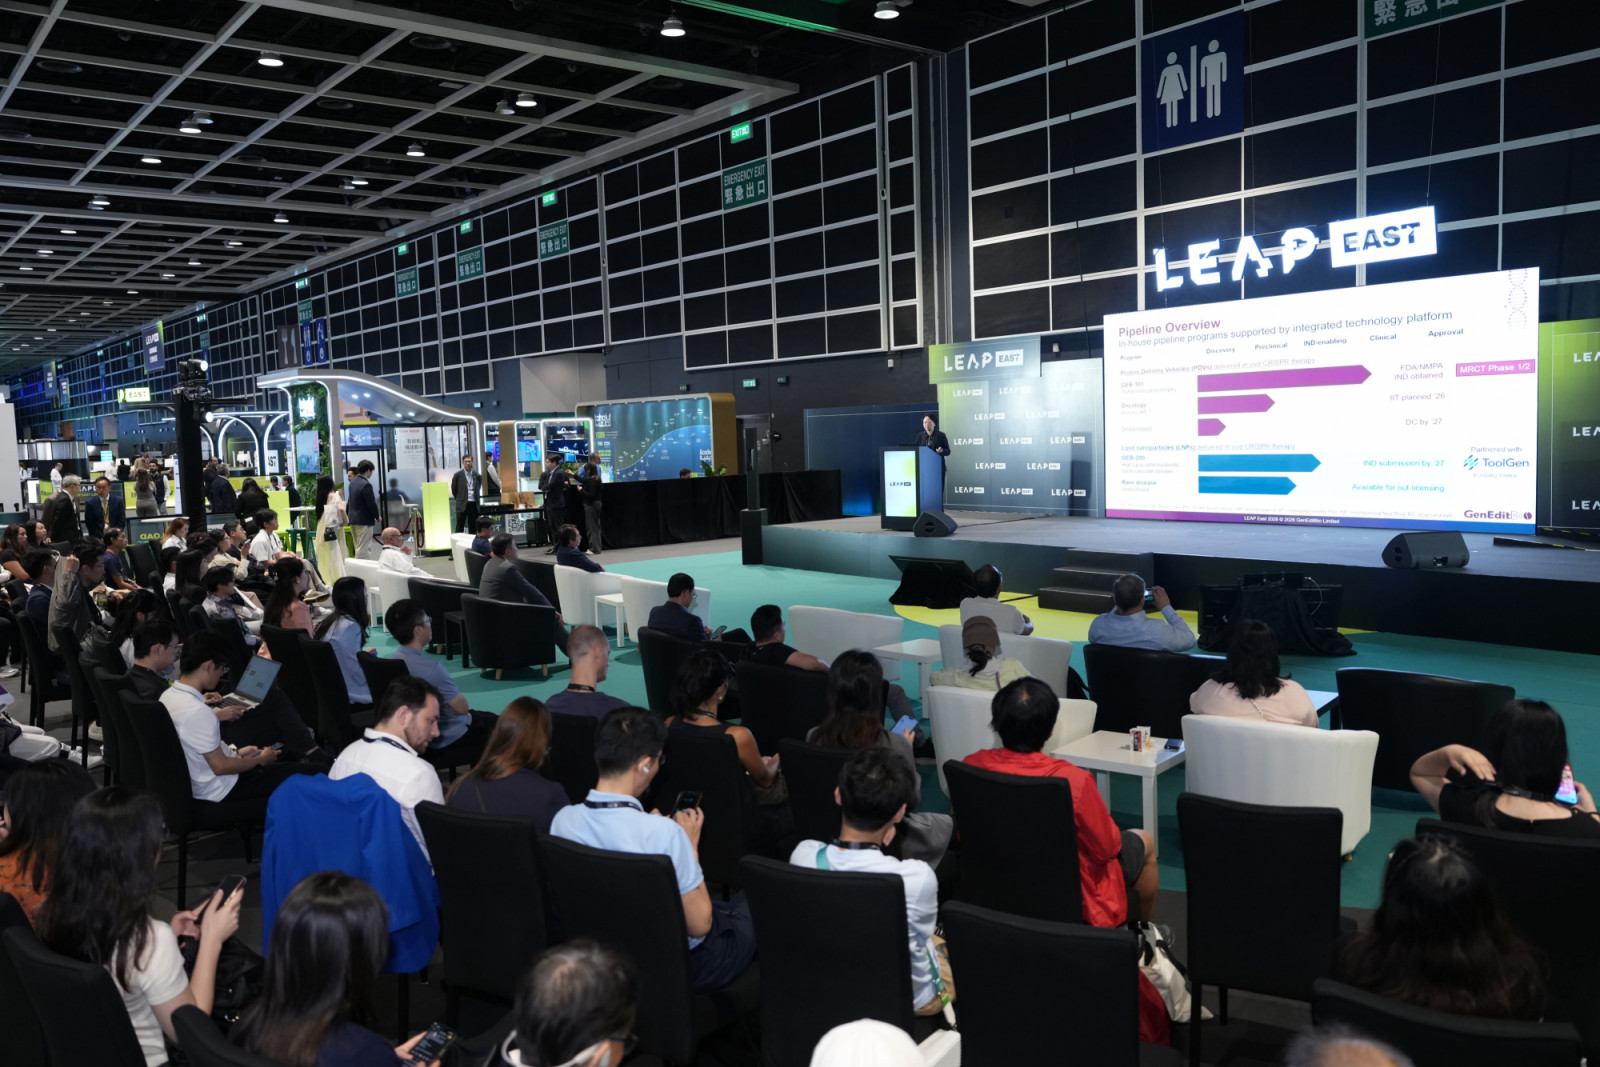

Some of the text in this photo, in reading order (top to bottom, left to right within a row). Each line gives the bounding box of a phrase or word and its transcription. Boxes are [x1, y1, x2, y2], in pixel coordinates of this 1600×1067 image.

[724, 164, 765, 186] EMERGENCY EXIT
[724, 180, 765, 204] 緊急出口
[540, 226, 559, 240] EMERGENCY
[1152, 222, 1422, 292] LEAP EAST
[1119, 320, 1221, 338] Pipeline Overview
[1119, 311, 1452, 347] In-house pipeline programs supported by integrated technology platform
[1206, 346, 1235, 354] Discovery
[1254, 342, 1288, 350] Preclinical
[1304, 338, 1347, 347] IND-enabling
[1428, 328, 1464, 338] Approval
[944, 352, 1020, 372] LEAP EAST
[1400, 362, 1443, 371] FDA/NMPA
[1488, 364, 1514, 372] Phase
[1518, 362, 1530, 370] 1/2
[1410, 372, 1443, 380] obtained
[1402, 393, 1431, 401] planned
[1420, 418, 1428, 426] by
[1422, 459, 1431, 468] by
[1482, 458, 1529, 467] ToolGen
[1398, 484, 1445, 493] out-licensing
